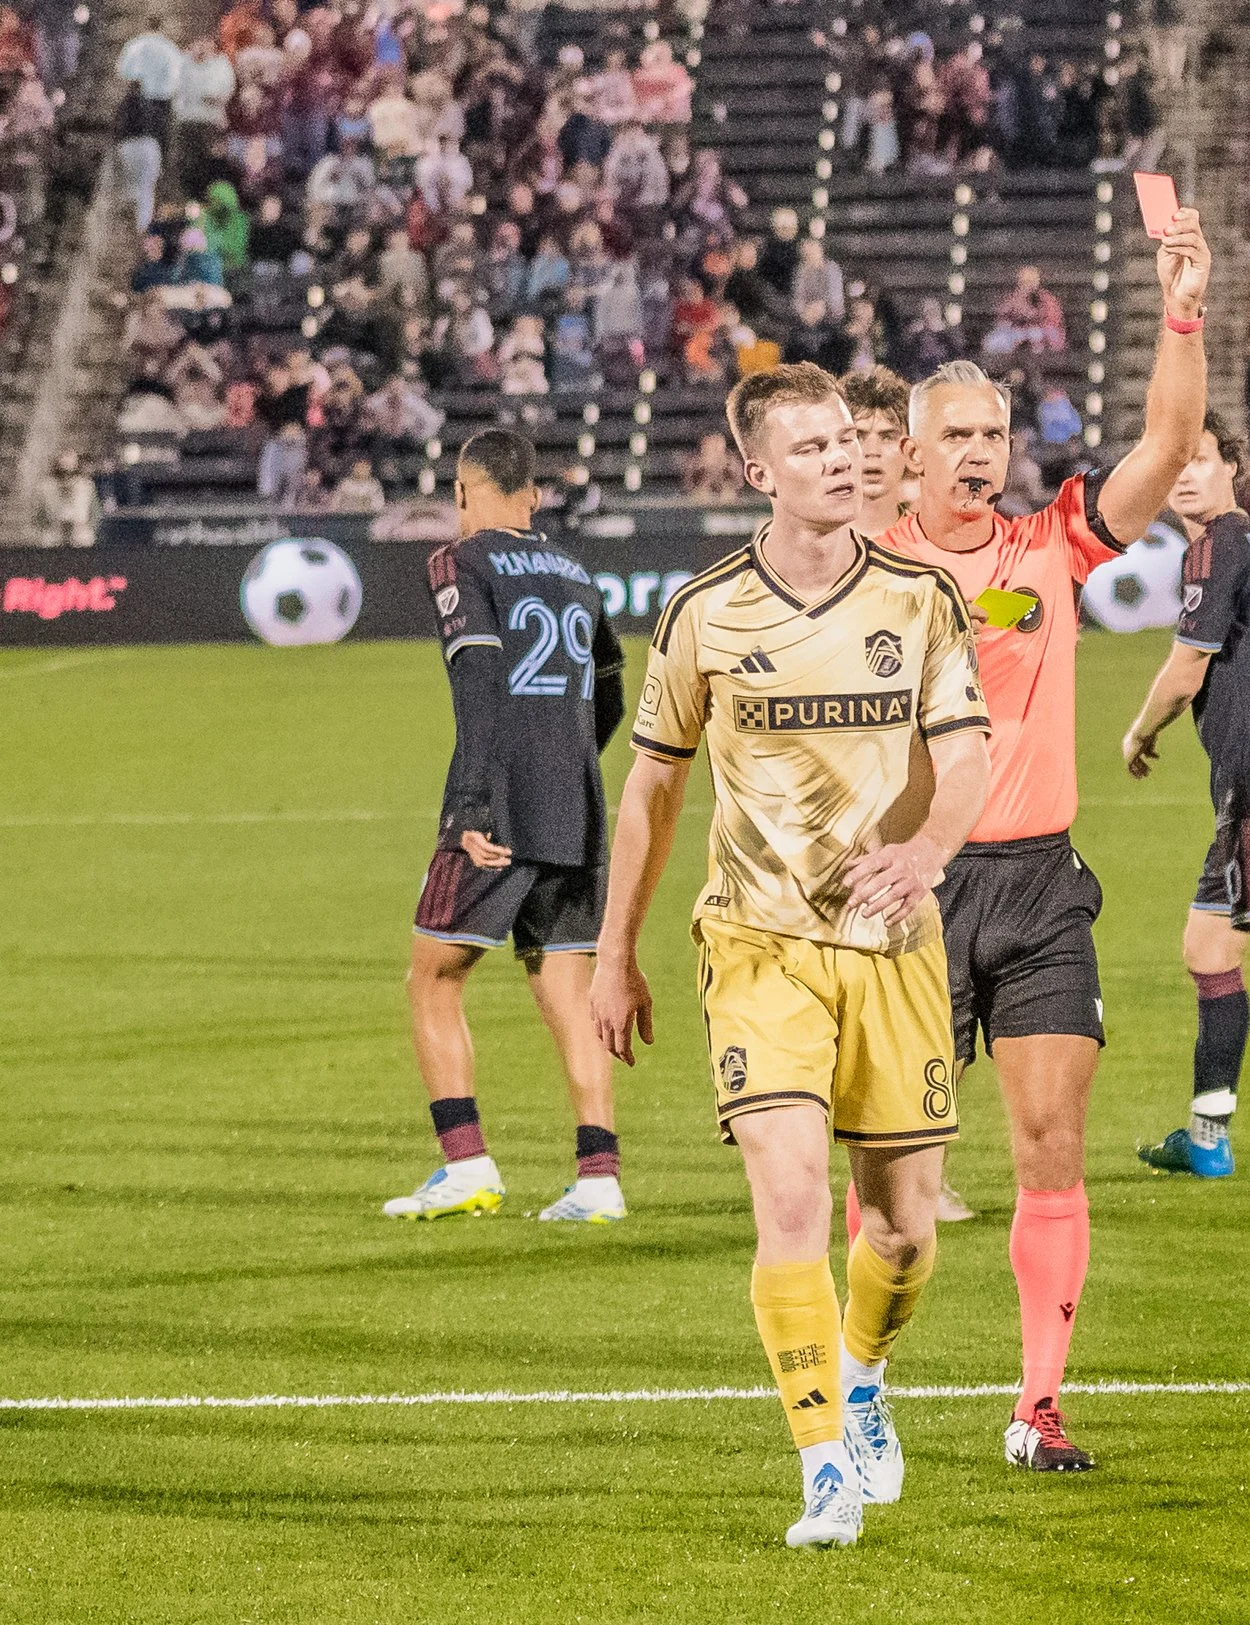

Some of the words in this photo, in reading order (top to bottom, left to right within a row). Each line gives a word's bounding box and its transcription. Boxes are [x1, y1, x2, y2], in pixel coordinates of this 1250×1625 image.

[508, 596, 595, 700] 29
[774, 697, 904, 726] PURINA
[923, 1056, 951, 1121] 8
